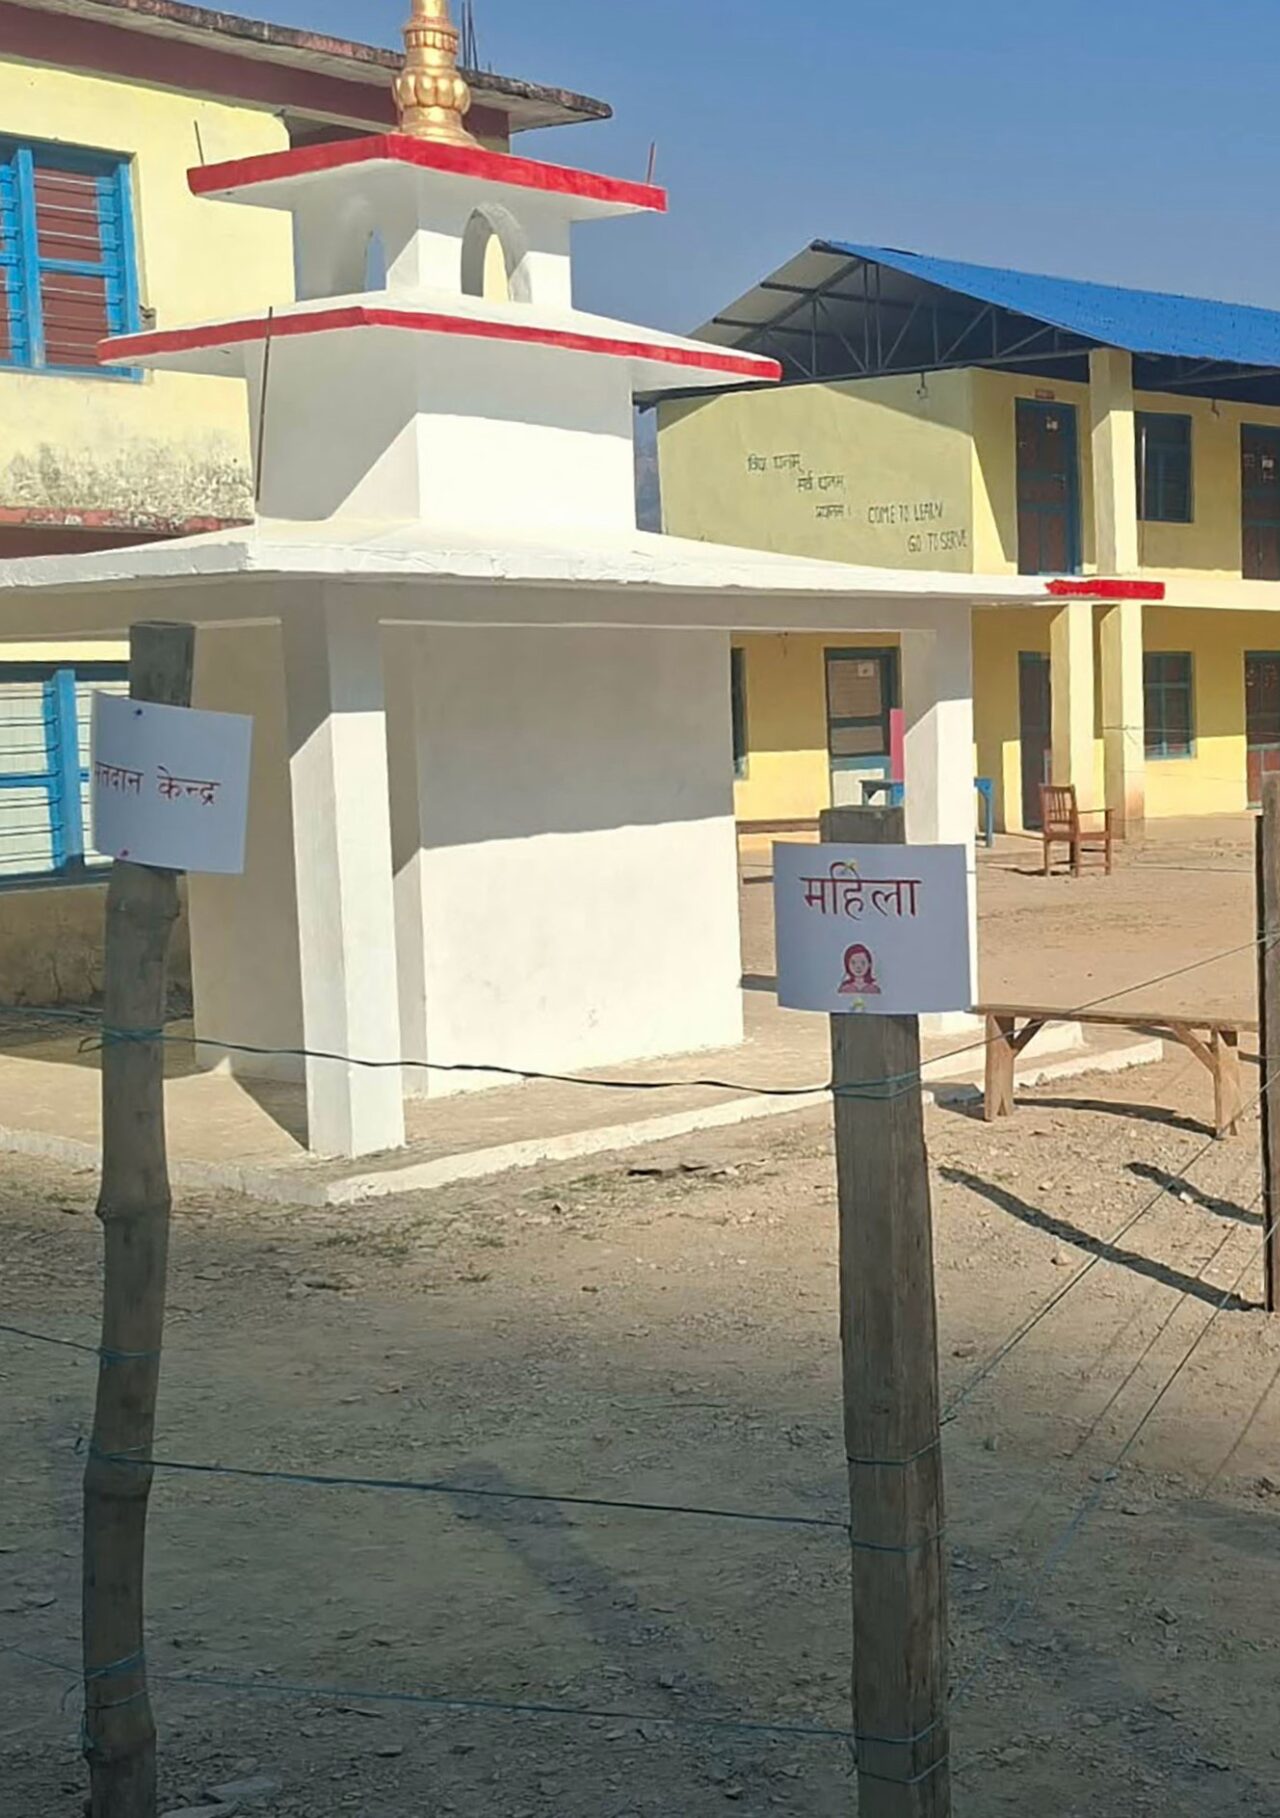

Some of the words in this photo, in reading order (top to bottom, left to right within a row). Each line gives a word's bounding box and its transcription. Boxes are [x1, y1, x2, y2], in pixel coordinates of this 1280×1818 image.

[867, 506, 896, 524] COME
[914, 502, 944, 521] LEARN
[907, 534, 922, 553] GO
[939, 529, 968, 550] SERVE
[157, 764, 221, 806] केन्द्र
[800, 861, 922, 920] महिला
